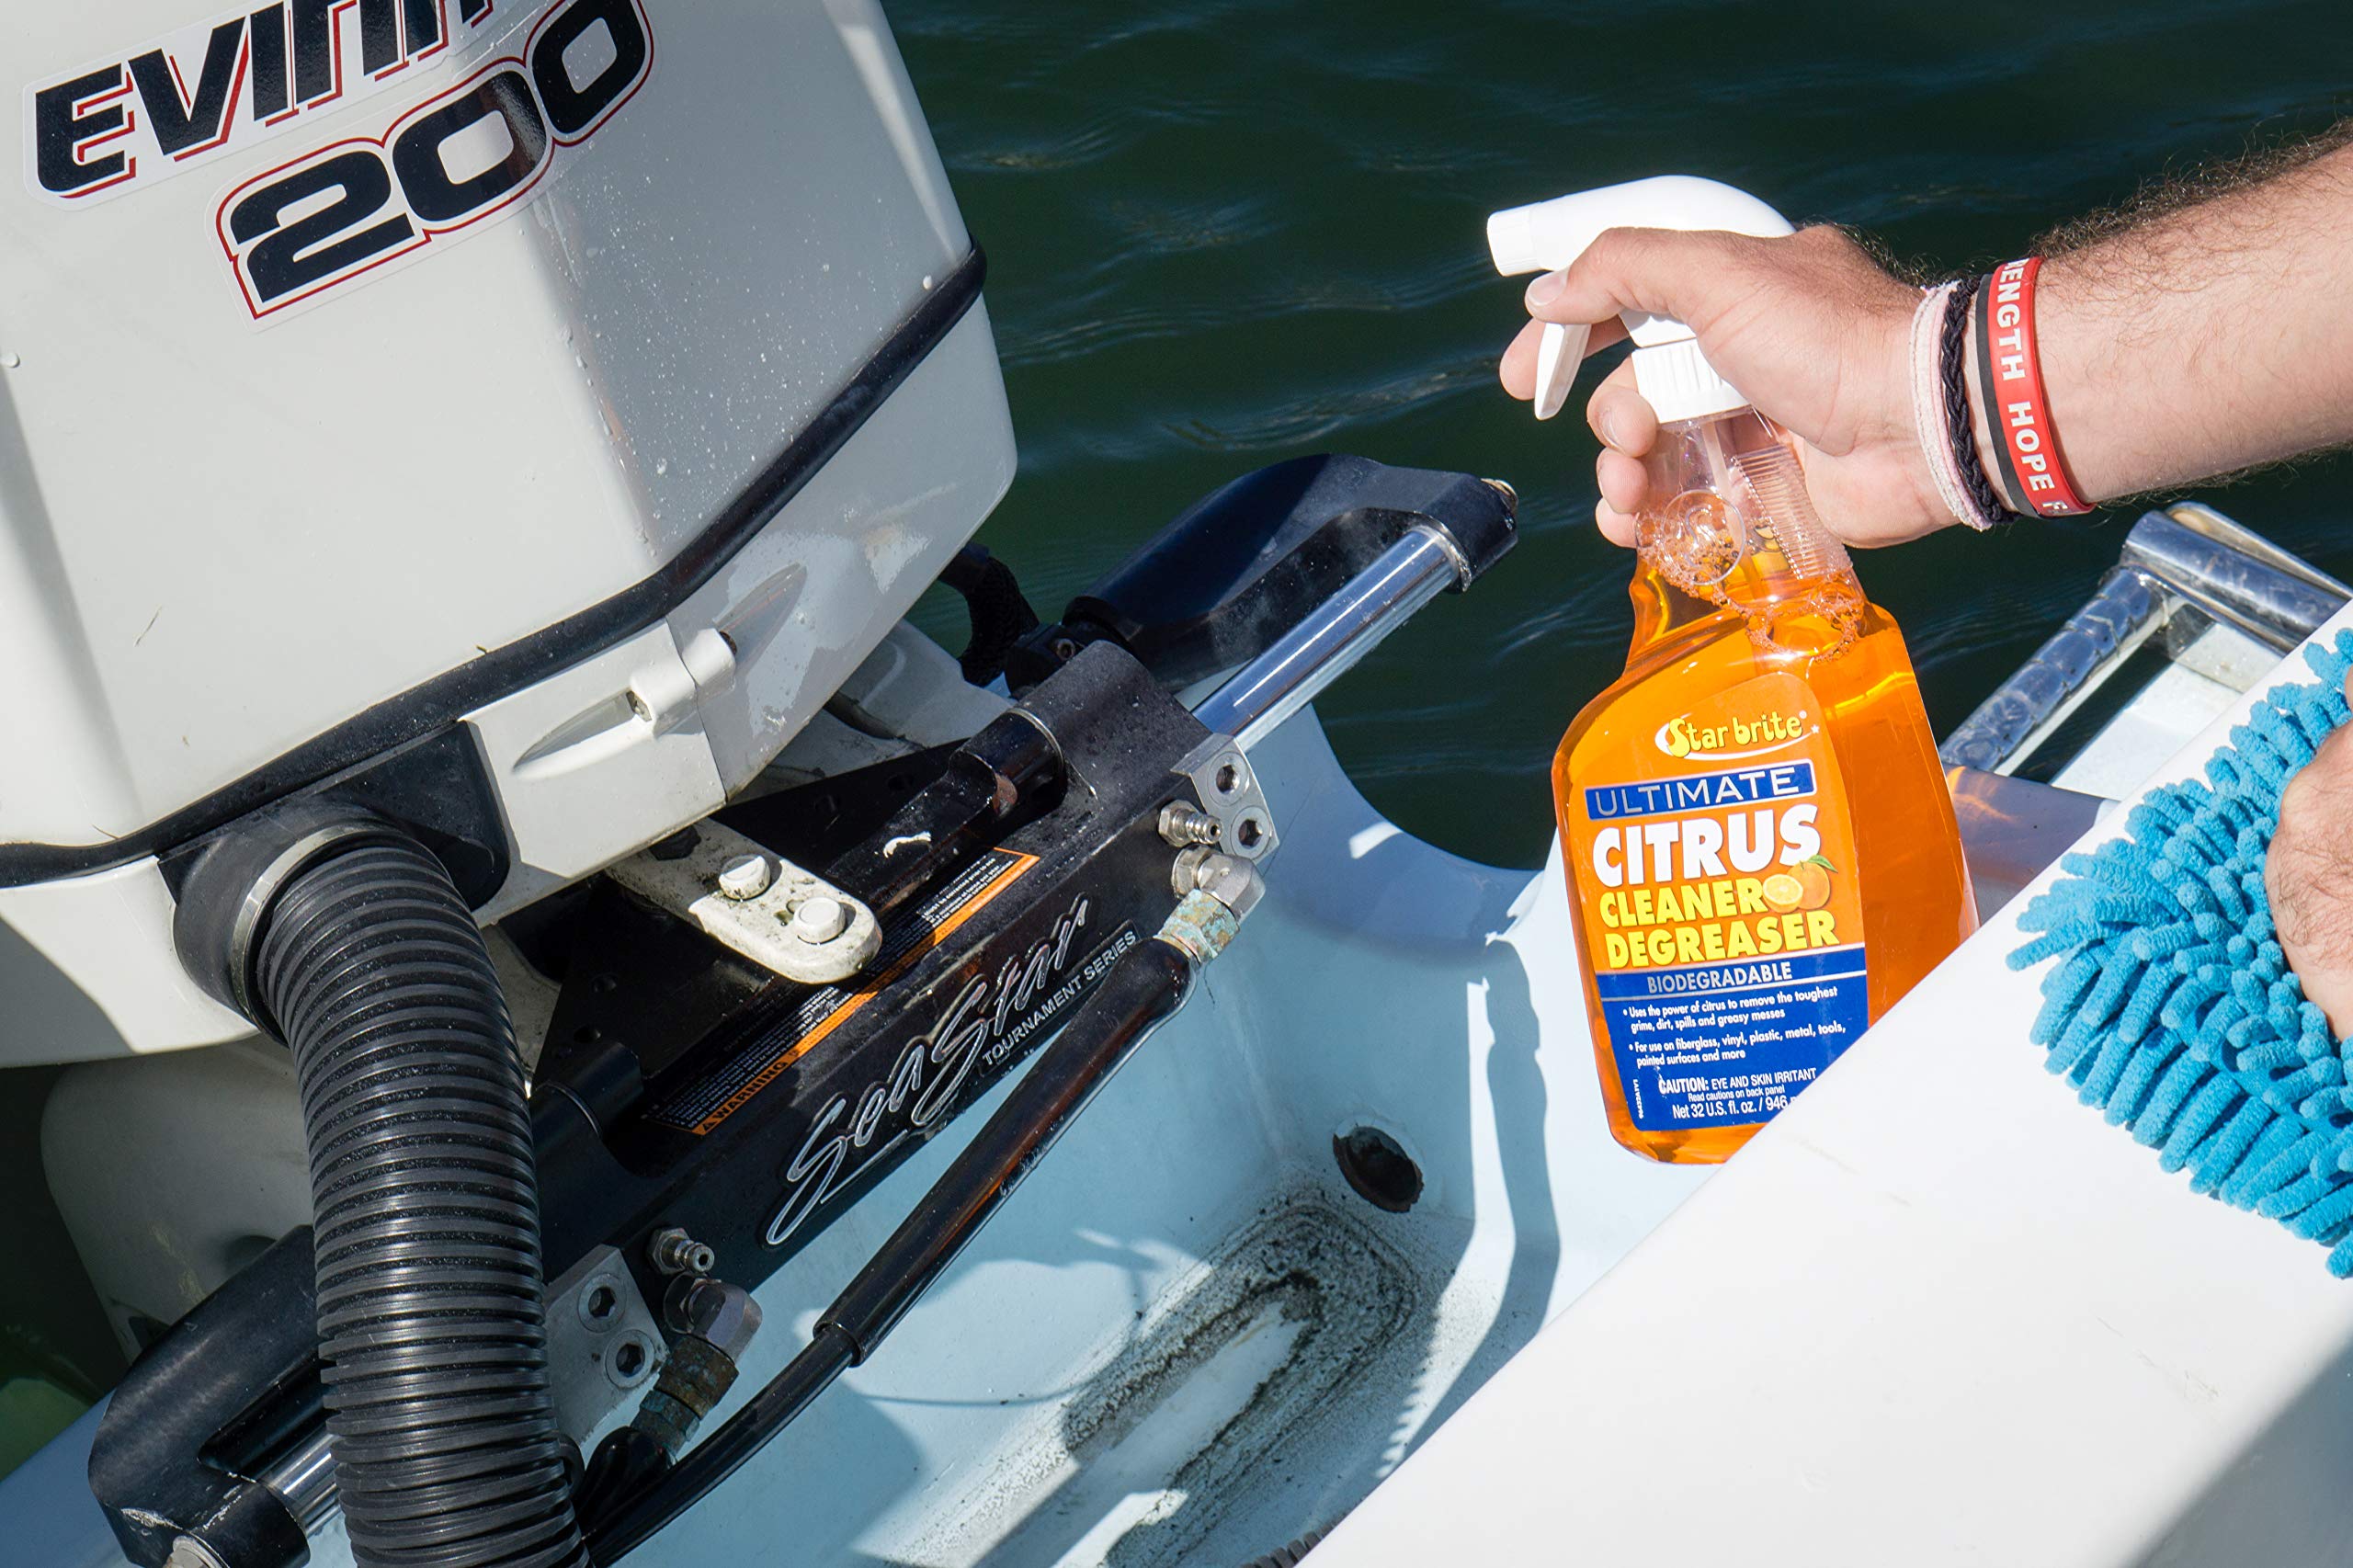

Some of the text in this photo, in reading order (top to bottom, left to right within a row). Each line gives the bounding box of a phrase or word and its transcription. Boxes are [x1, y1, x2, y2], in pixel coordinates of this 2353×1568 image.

[228, 0, 649, 306] 200
[2007, 401, 2055, 492] HOPE
[1595, 767, 1799, 816] ULTIMATE
[1593, 803, 1821, 887] CITRUS
[1599, 878, 1768, 928] CLEANER
[1605, 910, 1840, 969] DEGREASER
[983, 931, 1136, 1065] TOURNAMENT SERIES
[1647, 961, 1792, 994] BIODEGRADABLE
[1629, 986, 1837, 1018] Uses the power of citrus to remove the toughest
[1631, 1008, 1785, 1034] grime, dirt, spills and greasy messes
[1635, 1020, 1846, 1052] For use on fiberglass, vinyl, plastic, metal, tools,
[1636, 1048, 1745, 1069] painted surfaces and more
[713, 1062, 789, 1119] WARNING
[1658, 1067, 1816, 1094] CAUTION: EYE AND SKIN IRRITANT
[1688, 1084, 1785, 1102] Read cautions on back panel
[1673, 1104, 1690, 1119] Net
[1691, 1103, 1705, 1118] 32
[1706, 1101, 1727, 1117] U.S.
[1728, 1100, 1740, 1114] fl.
[1741, 1100, 1756, 1113] oz.
[1765, 1095, 1788, 1111] 946
